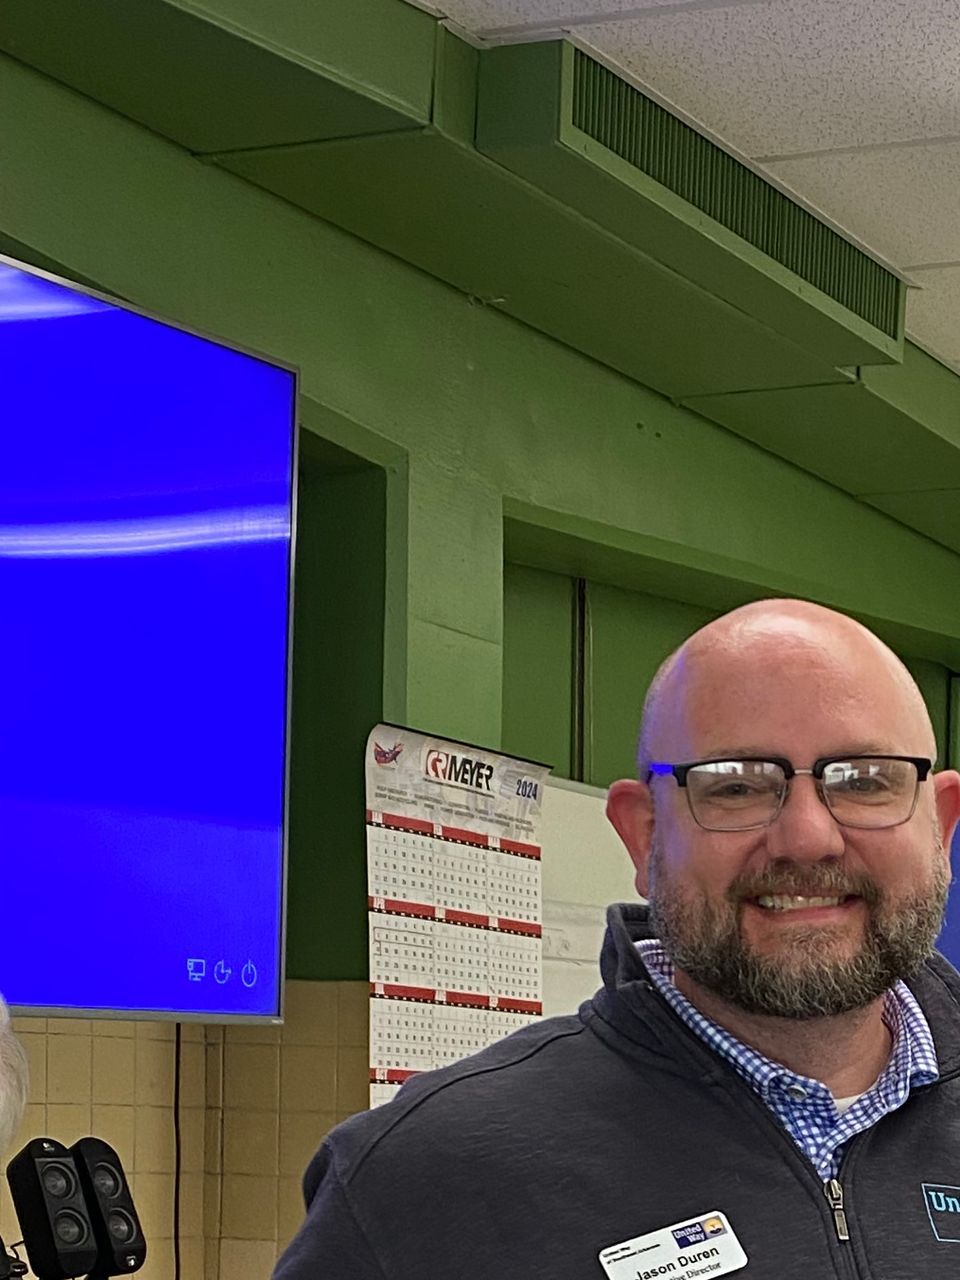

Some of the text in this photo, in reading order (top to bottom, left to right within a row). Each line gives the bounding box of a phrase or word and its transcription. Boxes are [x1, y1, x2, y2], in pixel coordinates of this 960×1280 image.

[448, 755, 494, 791] MEYER
[516, 778, 538, 800] 2024
[673, 1223, 702, 1239] United
[686, 1232, 706, 1243] Way
[678, 1247, 720, 1268] Duren
[686, 1262, 722, 1280] Director
